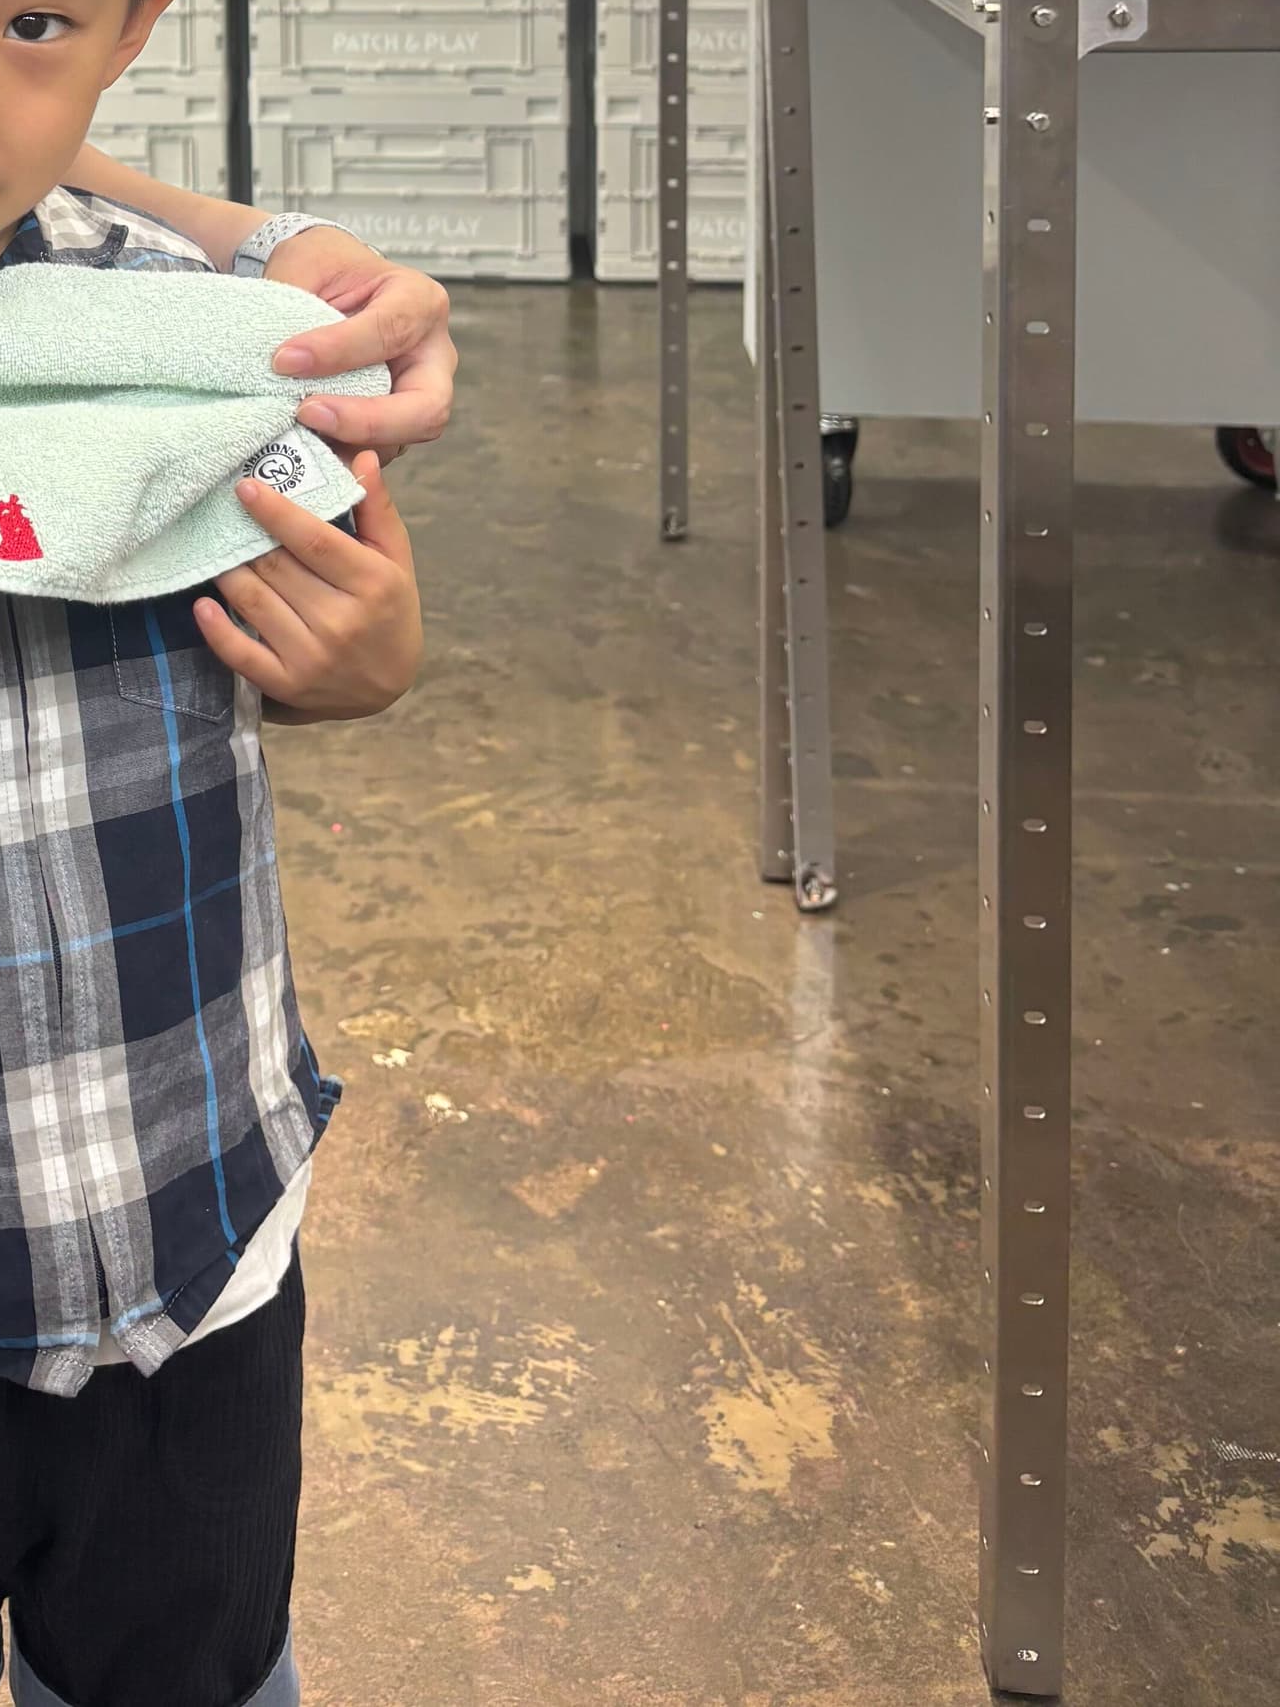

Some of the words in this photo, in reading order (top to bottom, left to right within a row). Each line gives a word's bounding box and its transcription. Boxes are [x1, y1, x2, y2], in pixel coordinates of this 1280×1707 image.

[332, 30, 399, 54] PATCH
[424, 30, 480, 54] PLAY
[427, 214, 481, 238] PLAY
